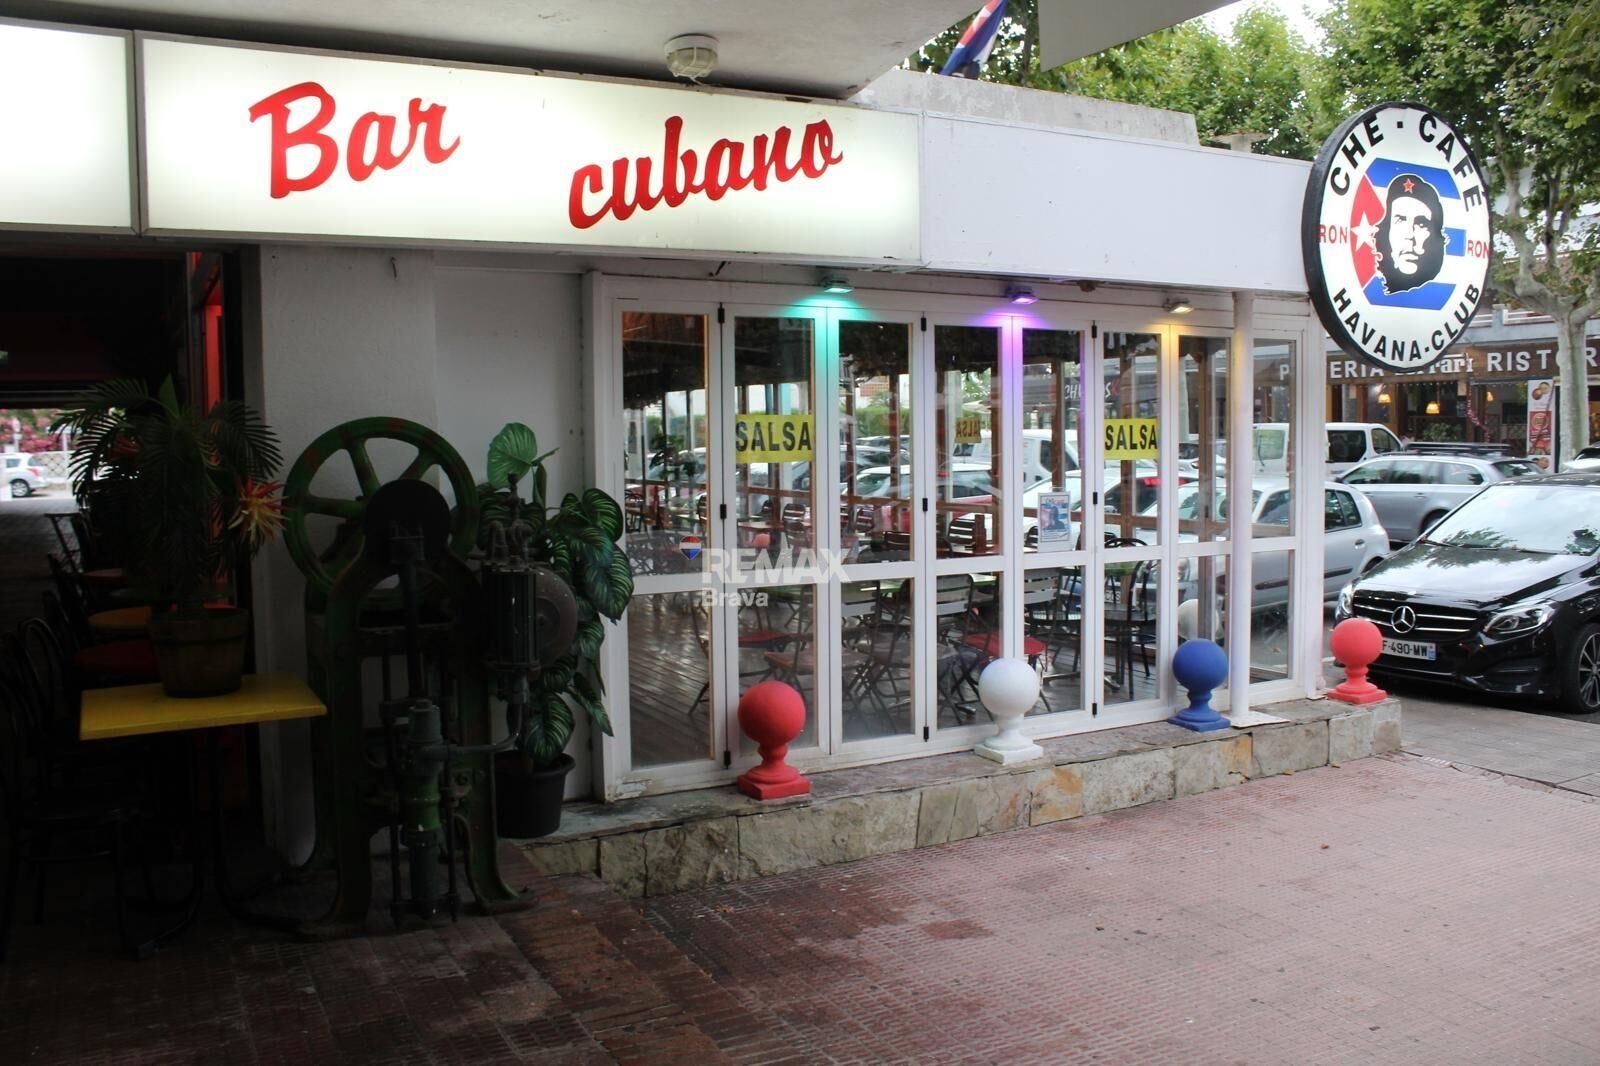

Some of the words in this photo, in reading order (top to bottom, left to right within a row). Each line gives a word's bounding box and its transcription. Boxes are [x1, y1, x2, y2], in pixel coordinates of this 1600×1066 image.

[249, 81, 461, 199] Bar
[569, 115, 843, 230] cubano
[1330, 114, 1384, 196] CHE
[1318, 224, 1348, 245] RON
[1467, 239, 1491, 258] RON
[1487, 346, 1598, 372] RISTR
[735, 421, 812, 451] SALSA
[1104, 424, 1158, 451] SALSA
[1382, 640, 1428, 657] F-490-MW
